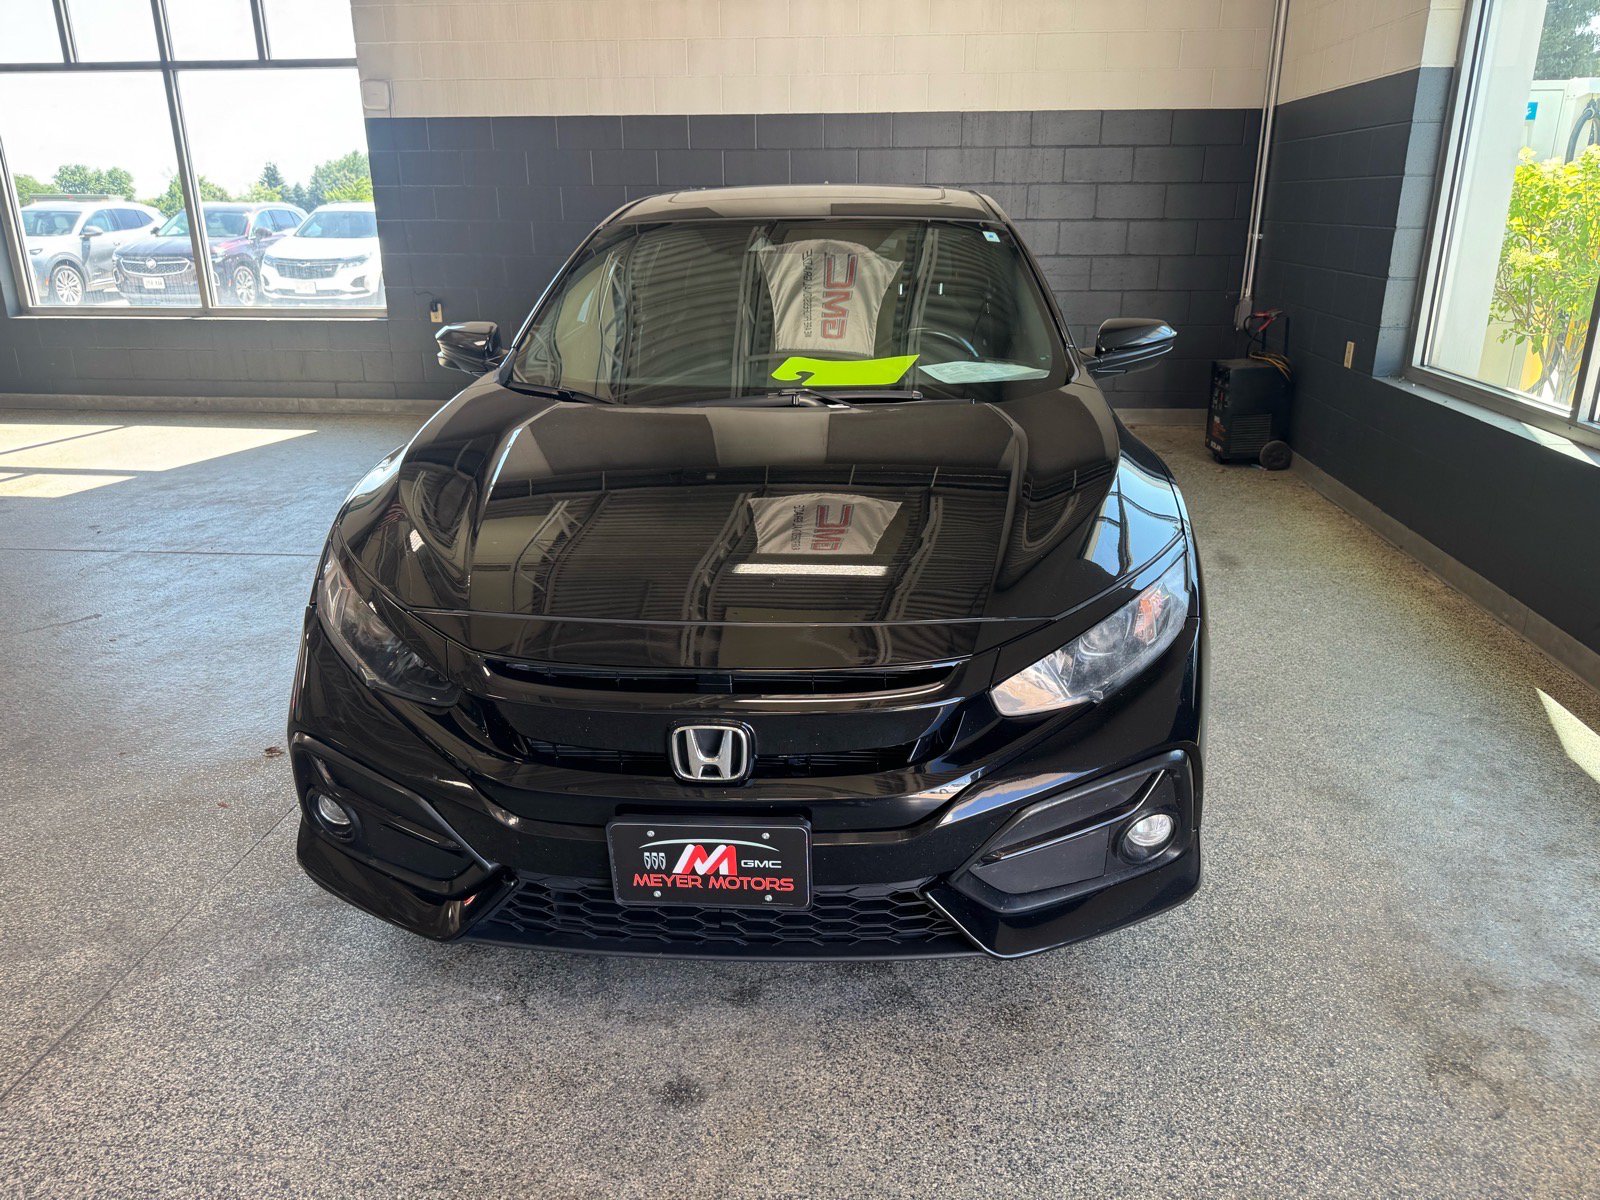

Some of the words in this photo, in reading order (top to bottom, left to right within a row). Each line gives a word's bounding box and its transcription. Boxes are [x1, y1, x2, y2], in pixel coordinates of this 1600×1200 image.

[741, 859, 782, 869] GMC
[633, 873, 703, 889] MEYER
[708, 875, 795, 892] MOTORS
